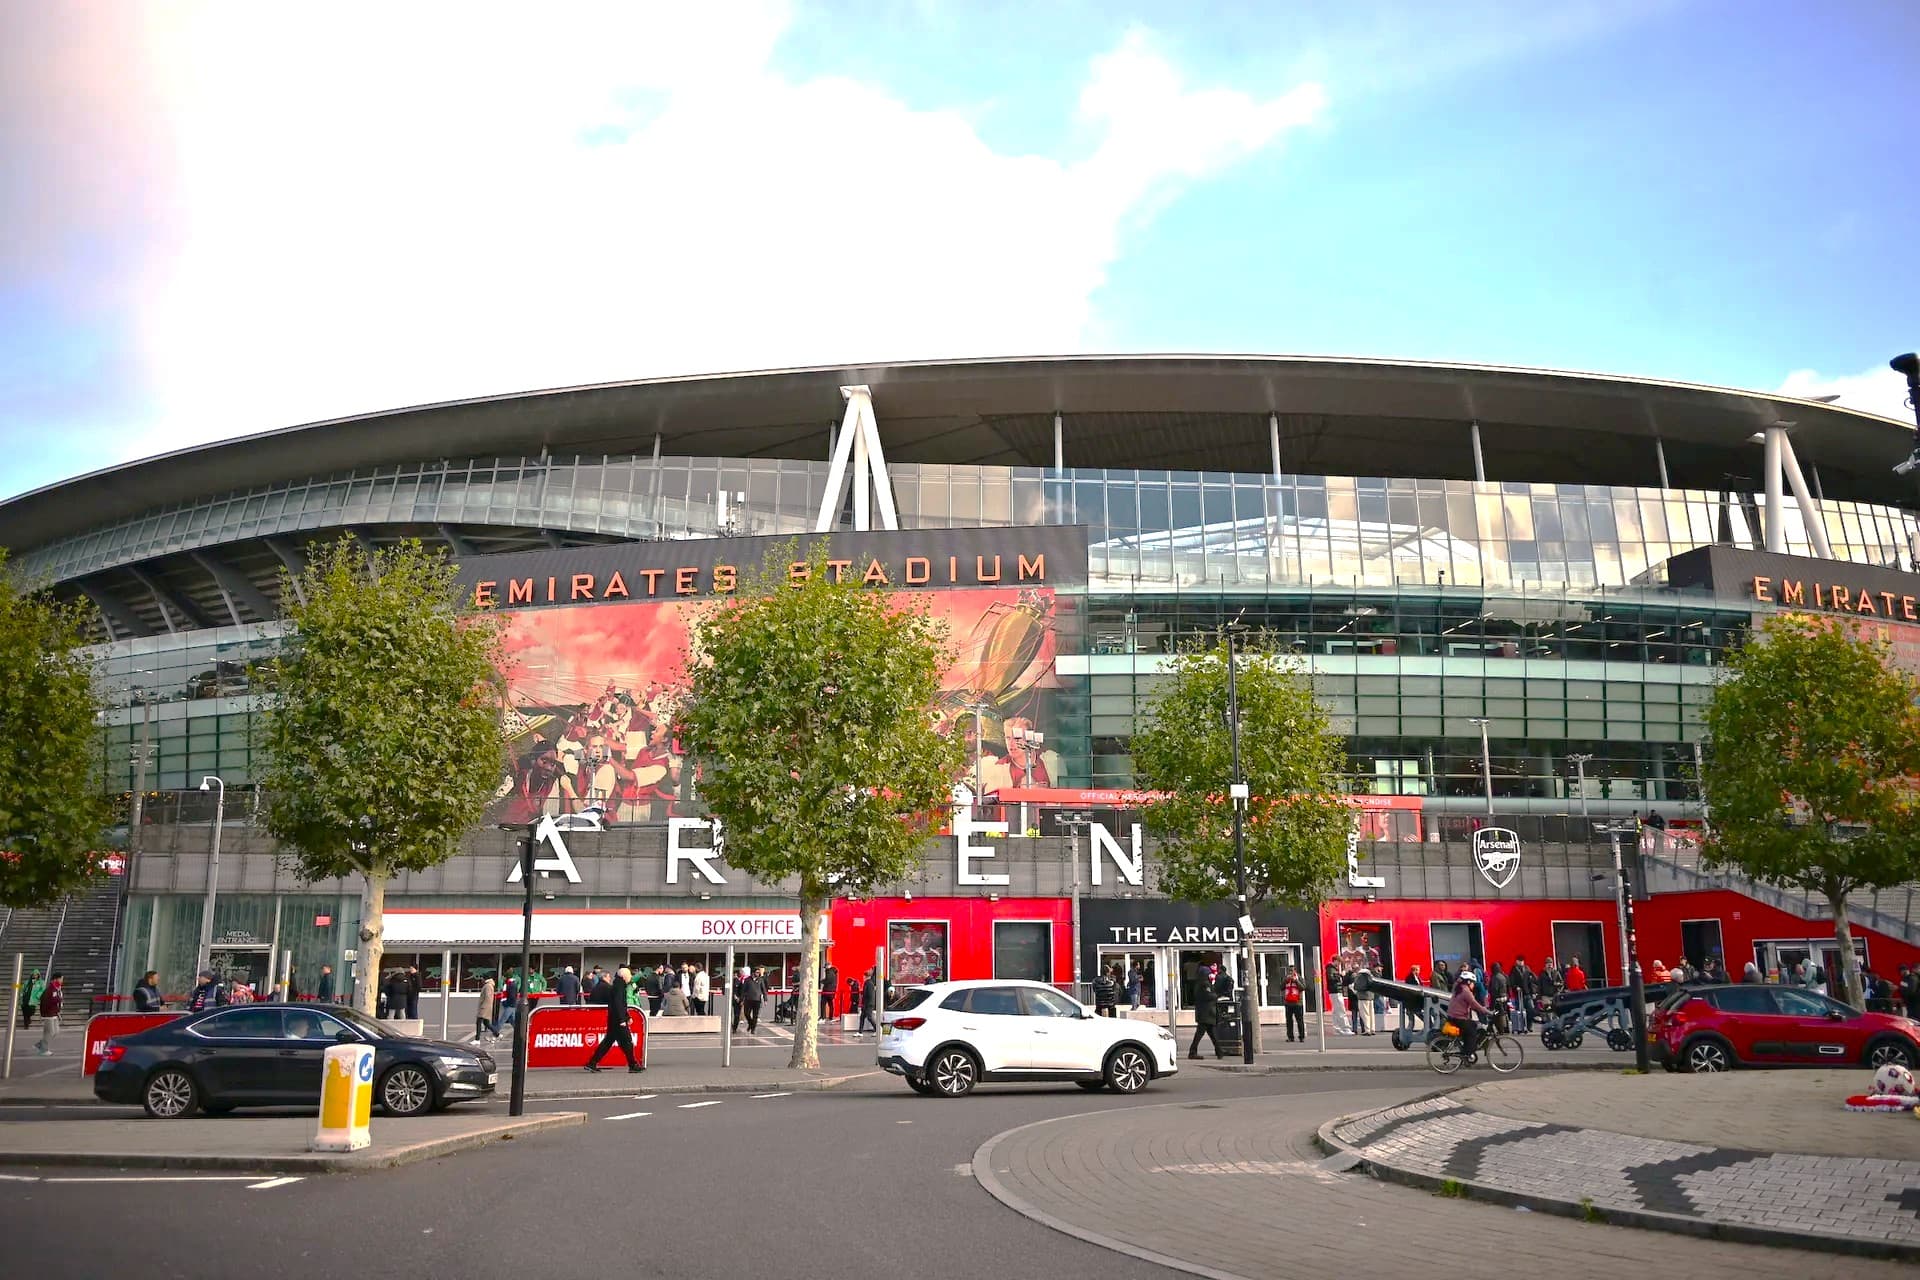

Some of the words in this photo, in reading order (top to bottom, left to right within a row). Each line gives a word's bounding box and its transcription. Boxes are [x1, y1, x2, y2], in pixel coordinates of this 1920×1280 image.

[475, 565, 736, 606] EMIRATES
[788, 553, 1045, 588] STADIUM
[1754, 575, 1918, 620] EMIRATE
[1080, 791, 1119, 801] OFFICIAL
[506, 812, 1386, 888] ARENL
[1479, 839, 1514, 850] Arsenal
[226, 930, 250, 938] MEDIA
[702, 919, 737, 936] BOX
[740, 919, 795, 936] OFFICE
[1109, 926, 1158, 943] THE
[1167, 926, 1238, 943] ARMO
[535, 1033, 584, 1048] ARSENAL
